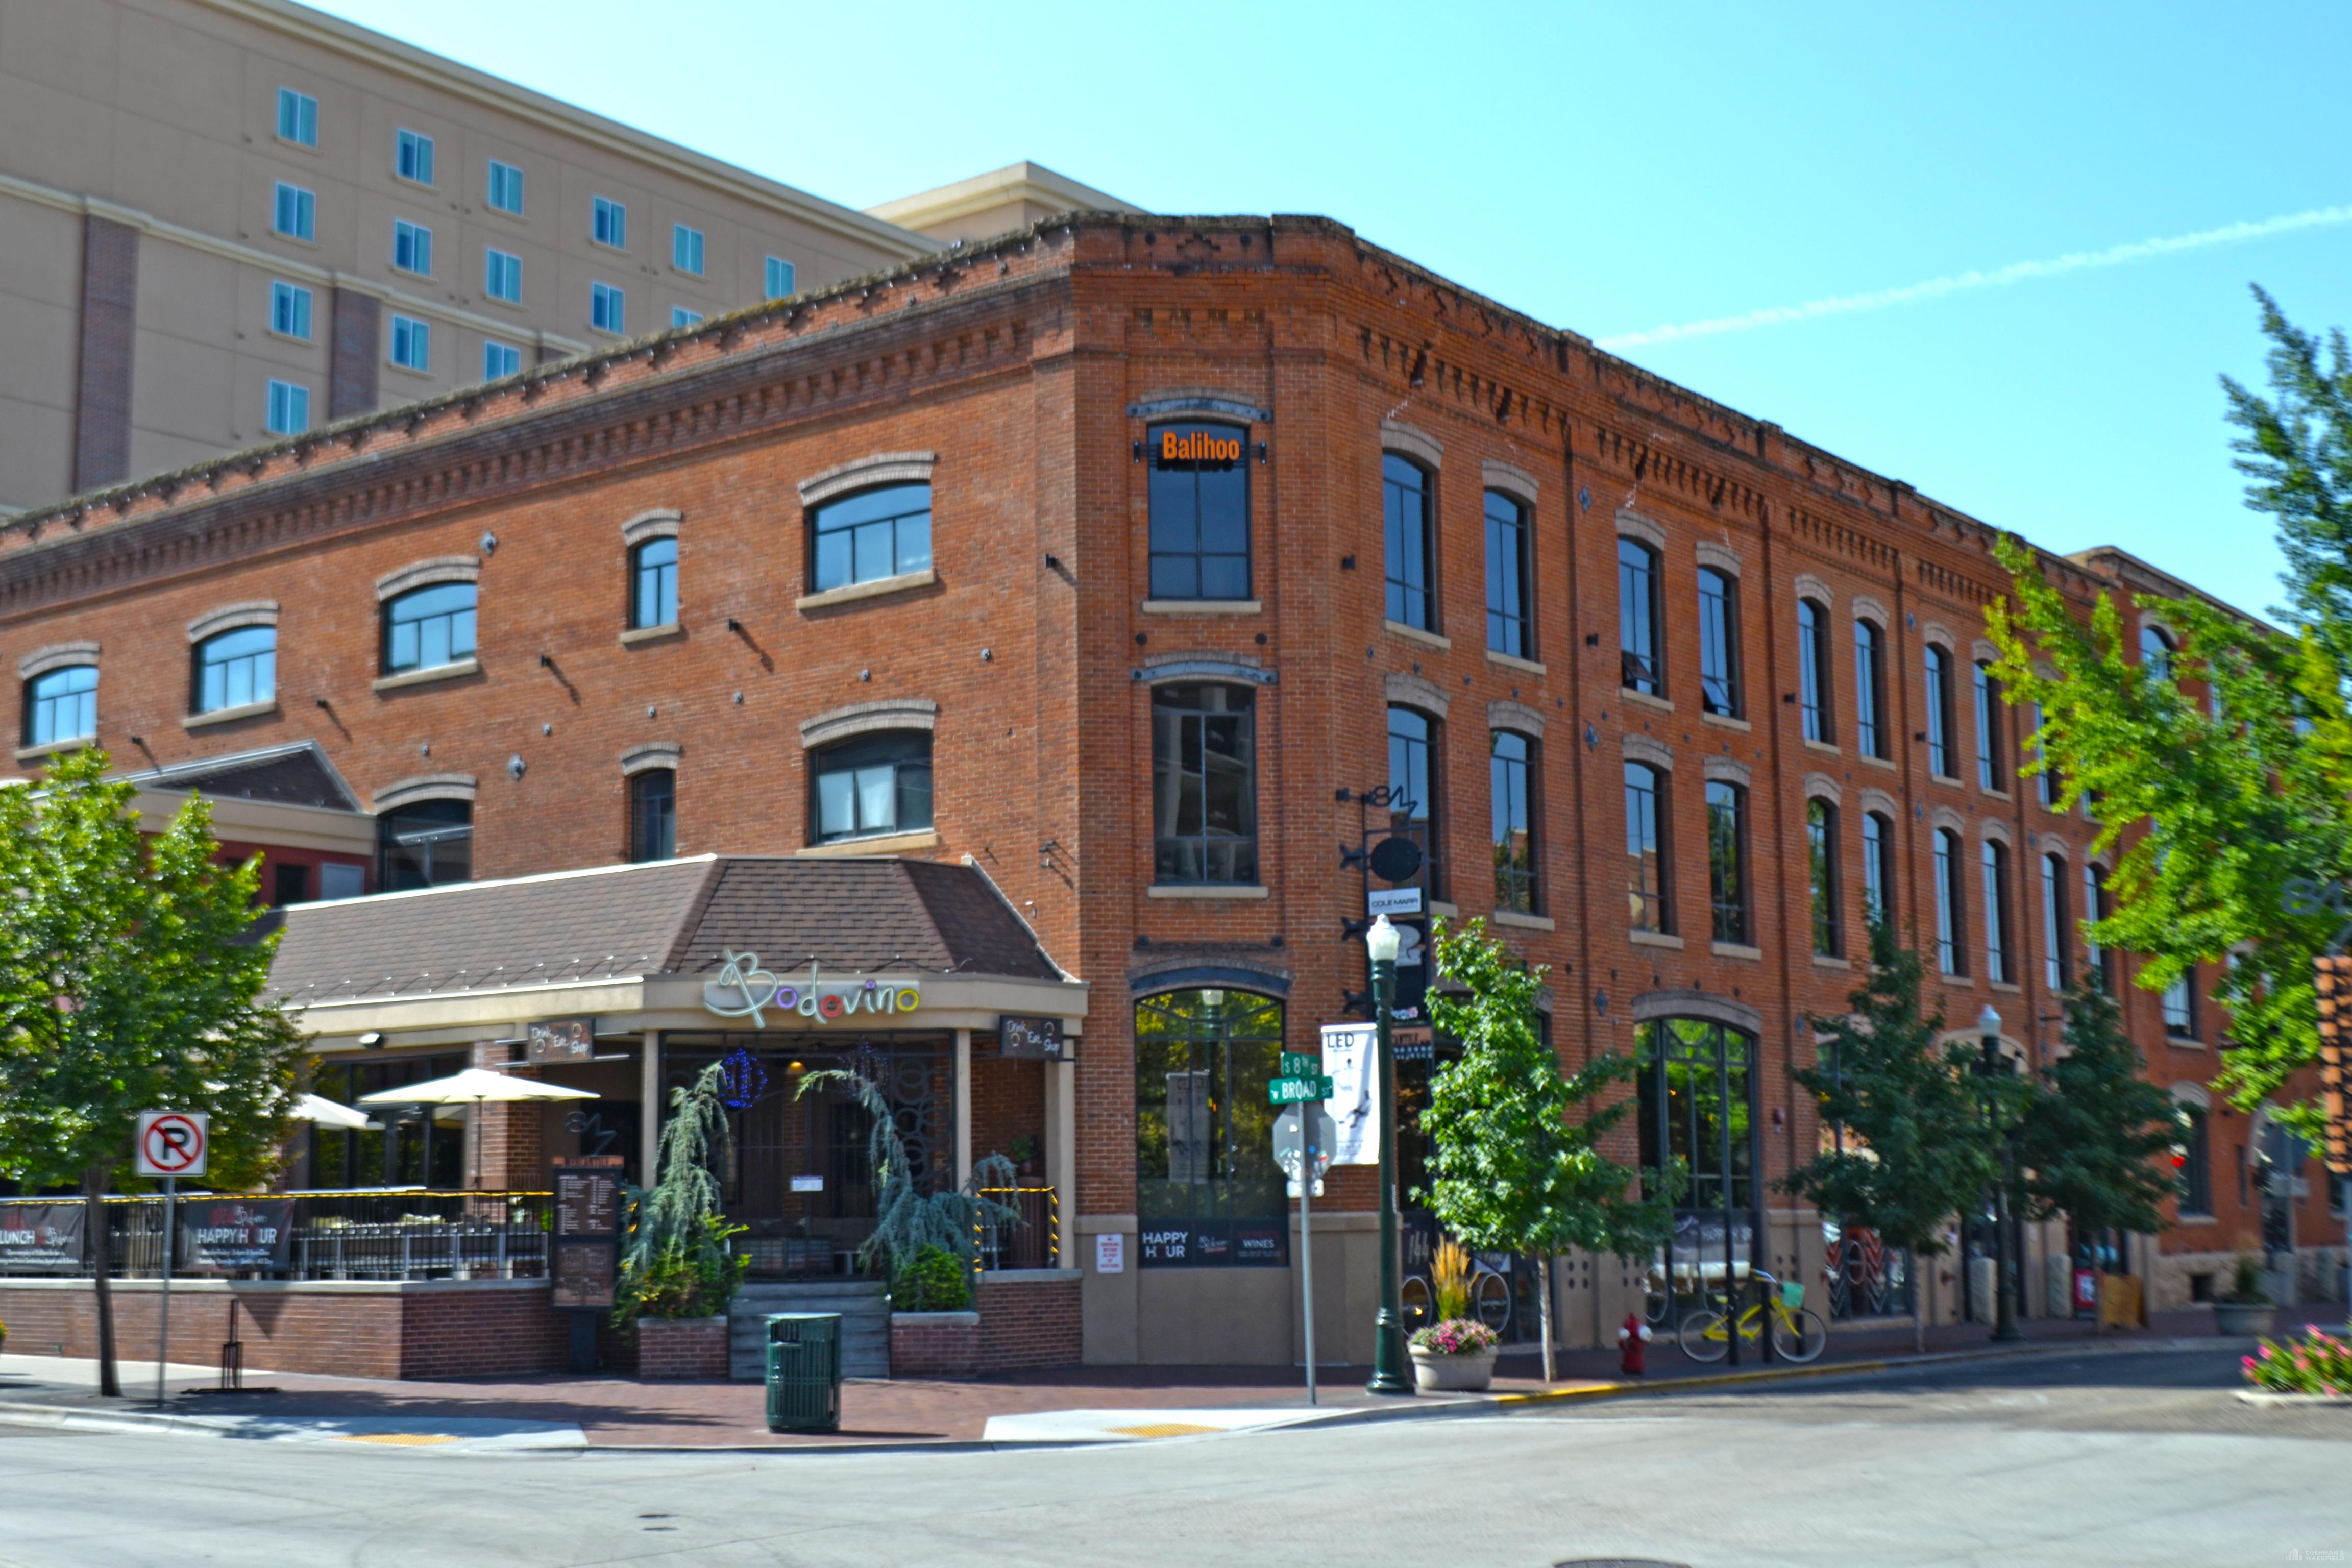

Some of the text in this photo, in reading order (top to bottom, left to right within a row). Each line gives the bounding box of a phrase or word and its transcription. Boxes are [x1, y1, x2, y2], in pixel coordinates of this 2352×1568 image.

[1162, 432, 1240, 460] Balihoo
[1371, 897, 1418, 908] COLE MARR
[703, 948, 919, 1029] Bodovino
[531, 1025, 554, 1039] Drink
[1007, 1020, 1028, 1033] Drink
[553, 1035, 569, 1047] Eat
[1327, 1032, 1354, 1048] LED
[571, 1040, 589, 1057] Shop
[1284, 1062, 1291, 1073] S
[1311, 1063, 1319, 1075] ST
[1282, 1079, 1317, 1100] BROAD
[0, 1230, 35, 1244] LUNCH
[197, 1228, 237, 1244] HAPPY
[1142, 1231, 1189, 1244] HAPPY
[1242, 1238, 1275, 1248] WINES
